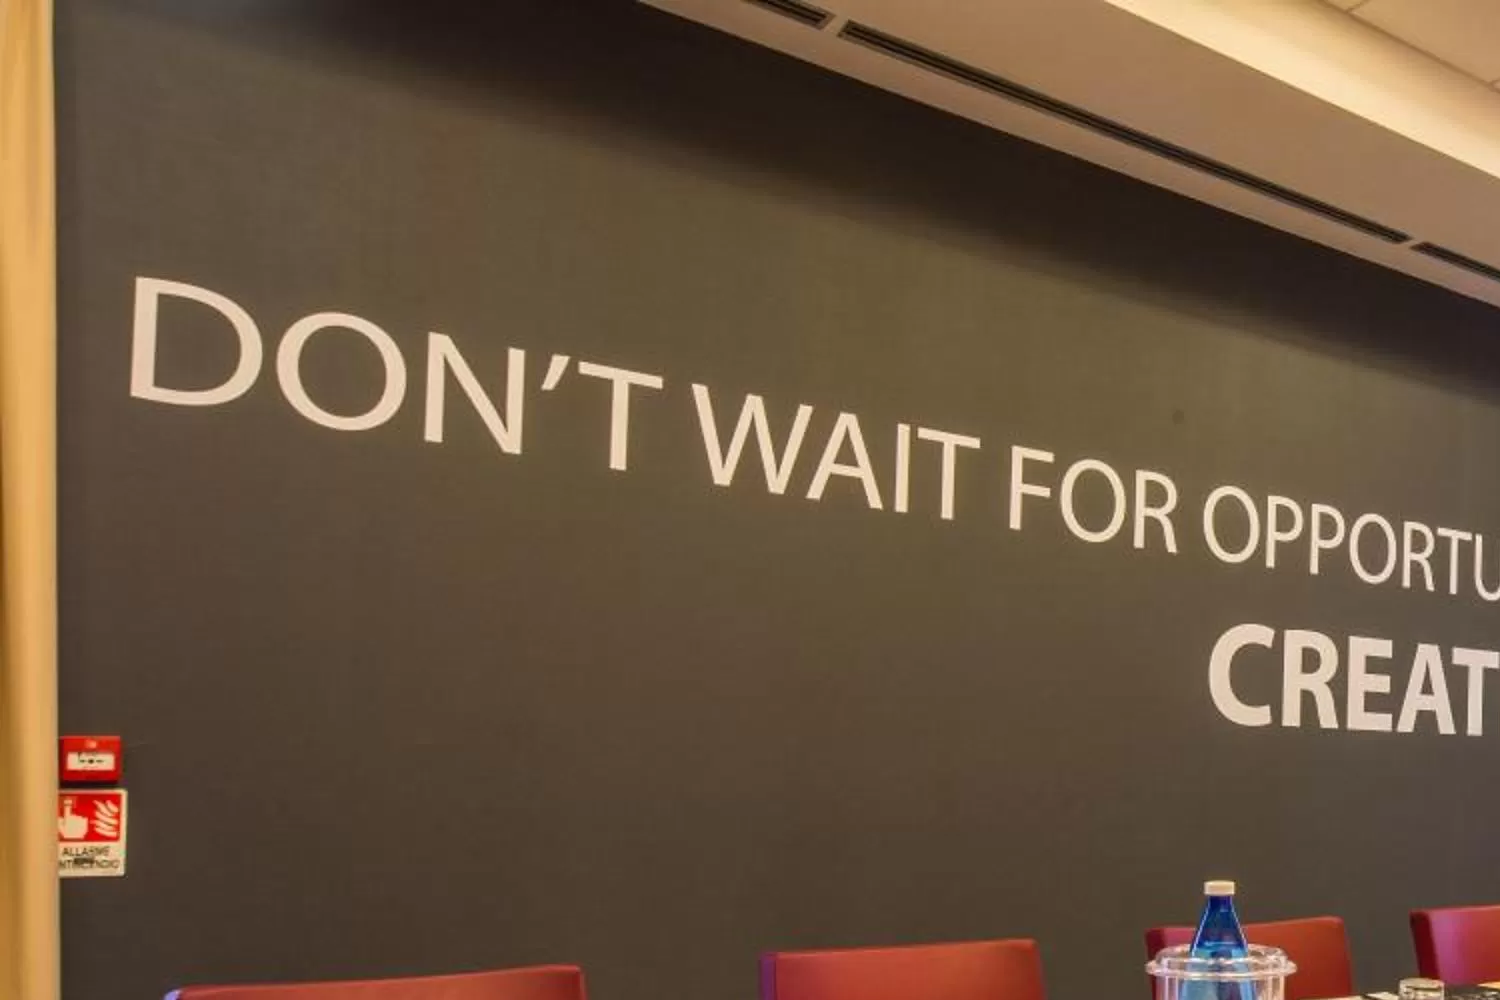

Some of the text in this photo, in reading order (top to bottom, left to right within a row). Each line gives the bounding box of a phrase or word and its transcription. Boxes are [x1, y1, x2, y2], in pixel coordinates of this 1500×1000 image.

[130, 276, 664, 472] DON'T
[691, 382, 981, 521] WAIT
[1008, 444, 1178, 554] FOR
